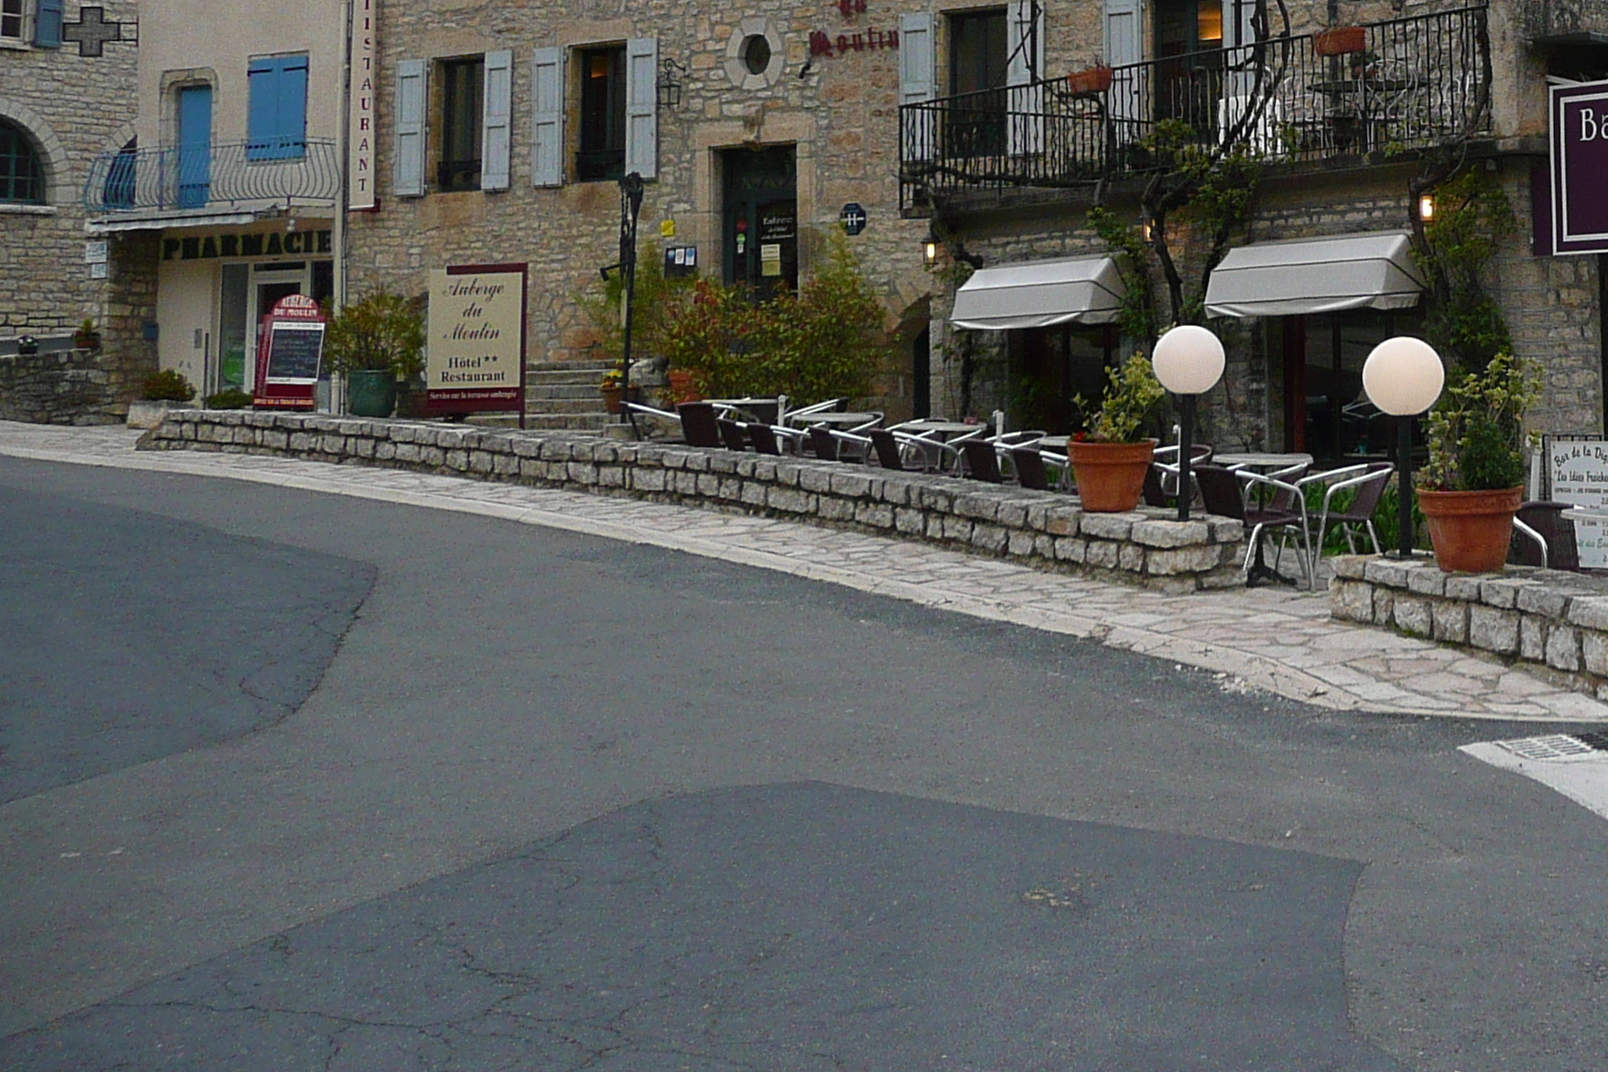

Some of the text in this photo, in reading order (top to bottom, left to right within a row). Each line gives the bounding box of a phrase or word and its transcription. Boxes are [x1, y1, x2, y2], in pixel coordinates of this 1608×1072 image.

[809, 27, 900, 57] Moulin
[163, 230, 332, 260] PHARMACIE
[442, 278, 504, 302] Auberge
[462, 302, 483, 318] du
[442, 322, 500, 340] Moulin
[441, 371, 505, 382] Restaurant
[1554, 453, 1569, 467] Bar
[1572, 446, 1580, 458] de
[1583, 444, 1591, 456] la
